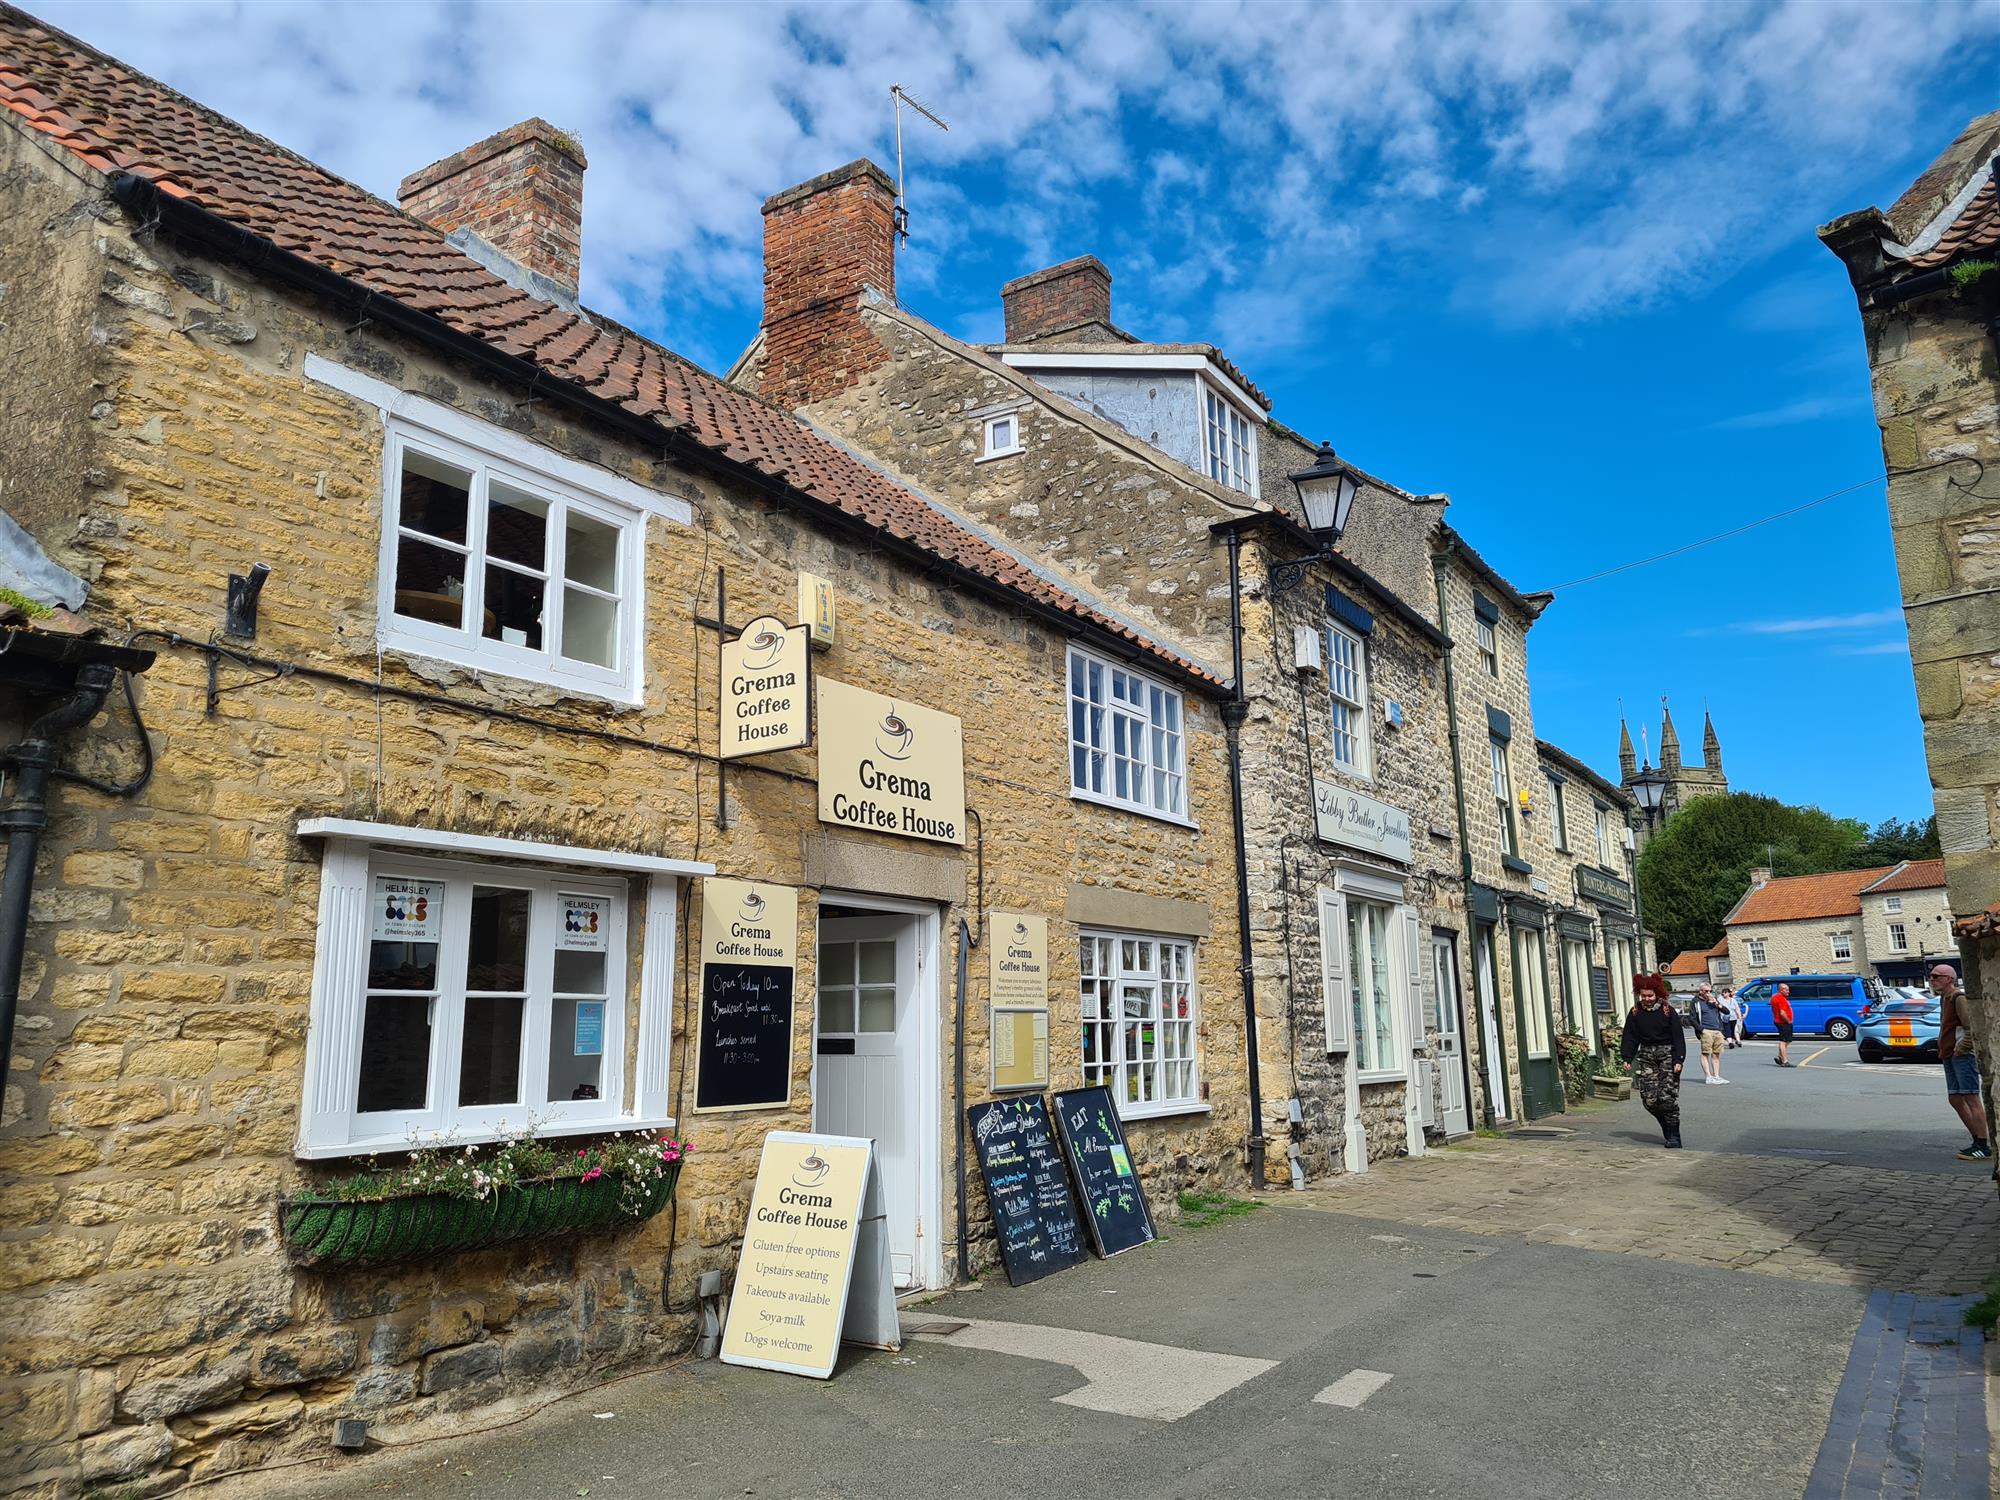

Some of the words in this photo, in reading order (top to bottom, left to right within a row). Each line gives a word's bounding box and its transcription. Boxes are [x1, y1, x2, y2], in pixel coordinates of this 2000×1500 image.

[731, 672, 796, 696] Crema
[736, 698, 791, 719] Coffee
[738, 720, 788, 742] House
[859, 759, 932, 802] Crema
[833, 794, 897, 828] Coffee
[902, 807, 955, 839] House
[1318, 787, 1344, 830] Libby
[1347, 796, 1376, 829] Butler
[386, 884, 430, 895] HELMSLEY
[565, 900, 600, 910] HELMSLEY
[384, 928, 426, 936] @helmsley365
[731, 922, 770, 939] Crema
[716, 942, 750, 956] Coffee
[754, 944, 784, 958] House
[1007, 946, 1032, 959] Crema
[999, 960, 1020, 972] Coffee
[1022, 963, 1040, 973] House
[713, 974, 736, 996] Open
[738, 970, 760, 1000] Today
[711, 1000, 743, 1022] Breakfast
[716, 1028, 737, 1046] Lunches
[1070, 1106, 1088, 1132] EAT
[779, 1188, 832, 1208] Crema
[757, 1208, 802, 1225] Coffee
[805, 1212, 848, 1230] House
[753, 1239, 784, 1253] Gluten
[786, 1243, 803, 1255] free
[805, 1246, 840, 1259] options
[756, 1262, 793, 1277] Upstairs
[795, 1269, 829, 1284] seating
[746, 1285, 787, 1300] Takeouts
[788, 1290, 831, 1306] available
[760, 1310, 782, 1324] Soya
[784, 1314, 805, 1327] milk
[744, 1332, 768, 1348] Dogs
[770, 1338, 813, 1352] welcome
